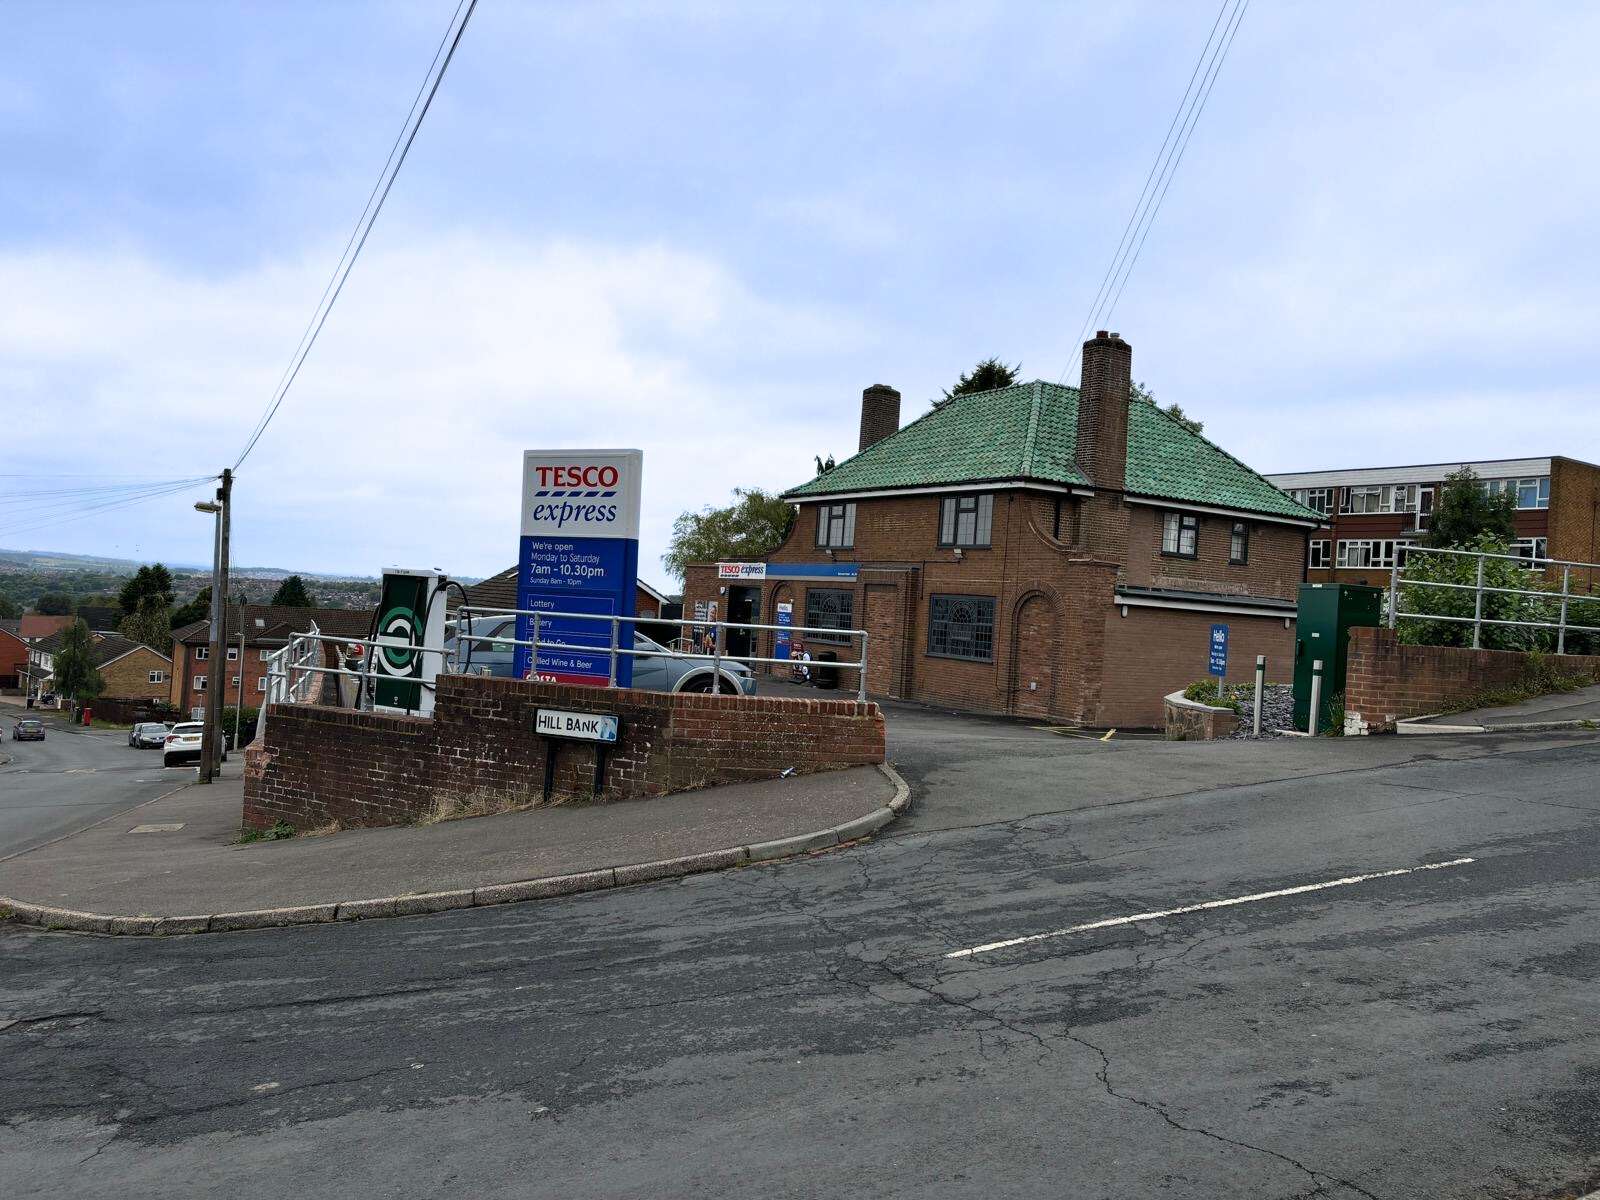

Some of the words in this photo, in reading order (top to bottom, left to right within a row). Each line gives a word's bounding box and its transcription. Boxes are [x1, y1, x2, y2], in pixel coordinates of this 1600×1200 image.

[535, 466, 619, 488] TESCO
[533, 501, 617, 528] express
[532, 541, 553, 550] We're
[554, 543, 574, 552] open
[531, 552, 559, 563] Monday
[560, 553, 568, 562] to
[569, 554, 601, 565] Saturday
[530, 563, 551, 574] 7am
[560, 564, 605, 579] 10.30pm
[720, 565, 740, 574] TESCO
[741, 565, 764, 576] express
[530, 577, 549, 585] Sunday
[530, 600, 555, 609] Lottery
[529, 618, 552, 628] Bery
[527, 656, 550, 666] Clled
[551, 658, 569, 667] Wine
[576, 660, 593, 669] Beer
[538, 714, 562, 730] HILL
[566, 717, 599, 733] BANK
